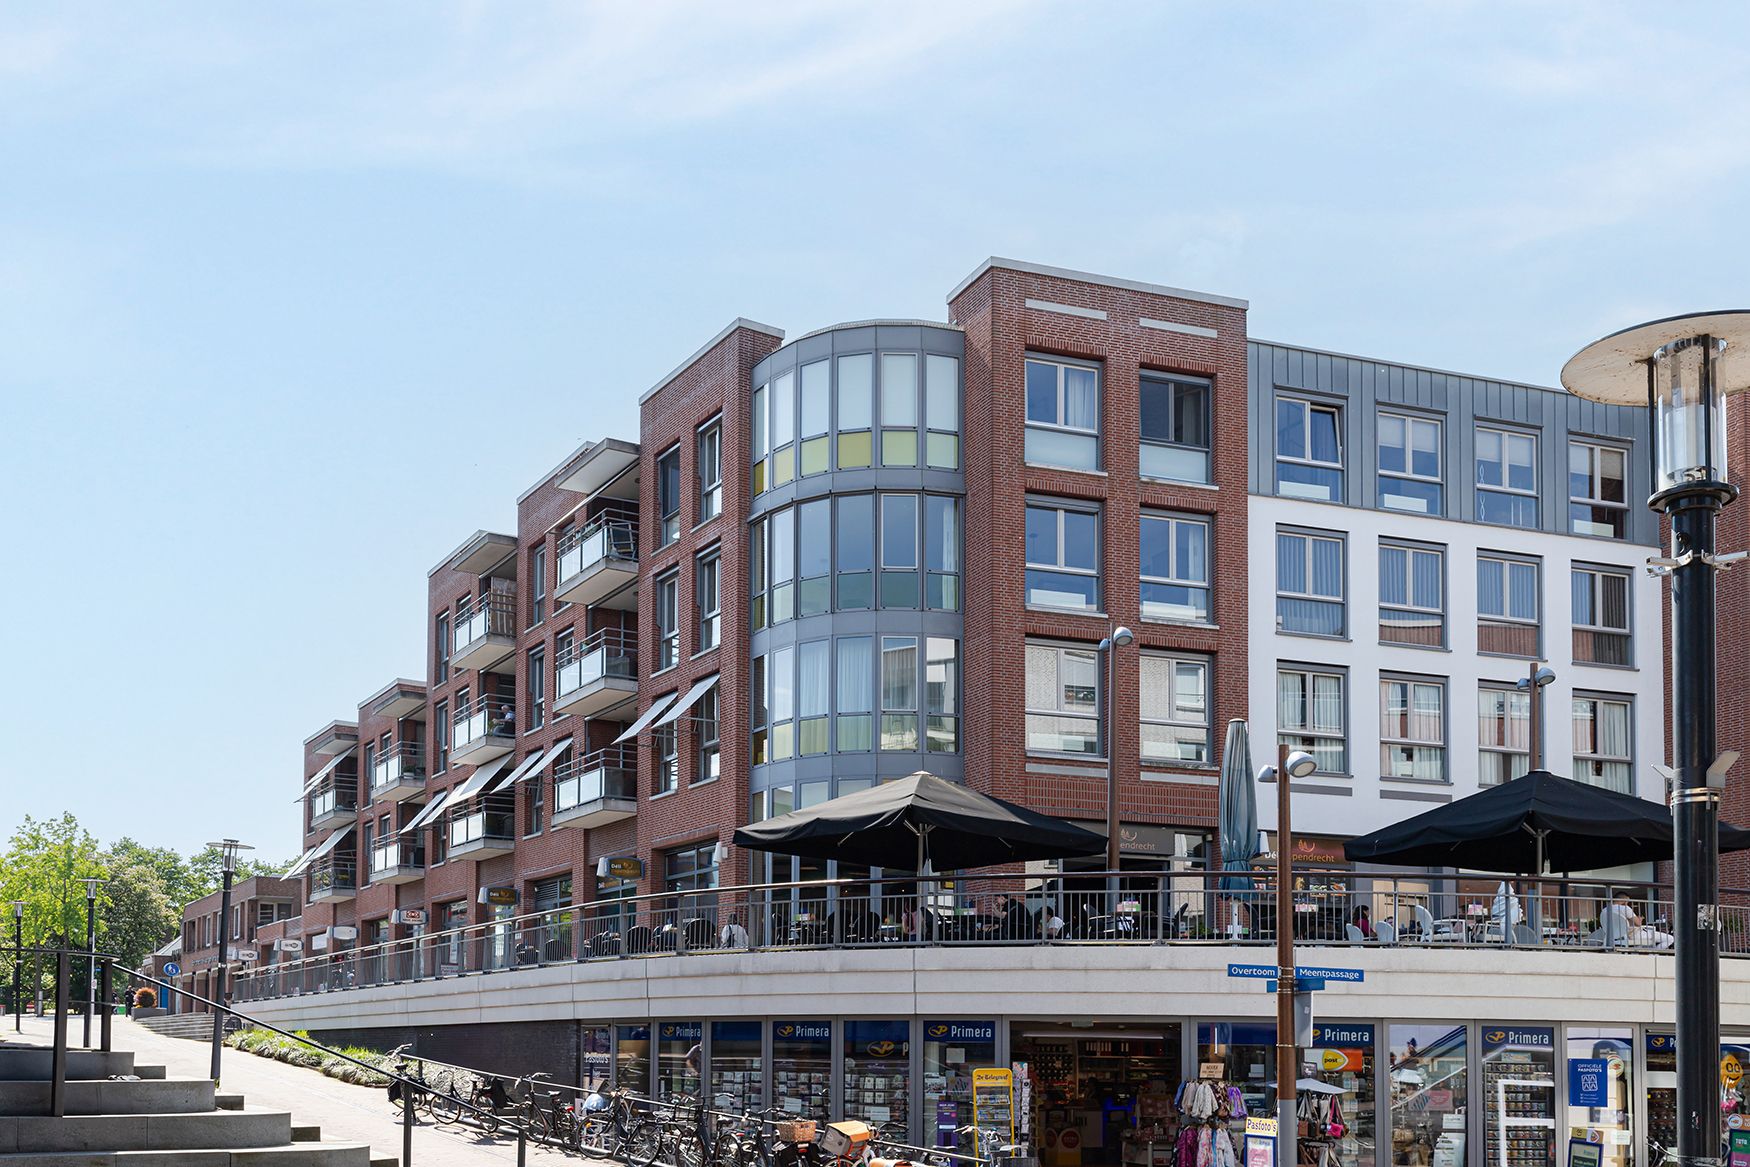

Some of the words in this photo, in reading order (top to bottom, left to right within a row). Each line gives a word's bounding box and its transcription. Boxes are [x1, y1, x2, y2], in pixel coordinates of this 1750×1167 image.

[1120, 842, 1155, 850] endrecht
[1292, 853, 1335, 862] pendrecht
[1231, 966, 1276, 976] Overtoom
[1299, 968, 1360, 980] Meentpassage
[675, 1026, 701, 1037] Primera
[795, 1025, 830, 1037] Primera
[951, 1025, 992, 1038] Primera
[1324, 1028, 1370, 1042] Primera
[1508, 1031, 1549, 1044] Primera
[1247, 1119, 1277, 1132] Pasfoto's
